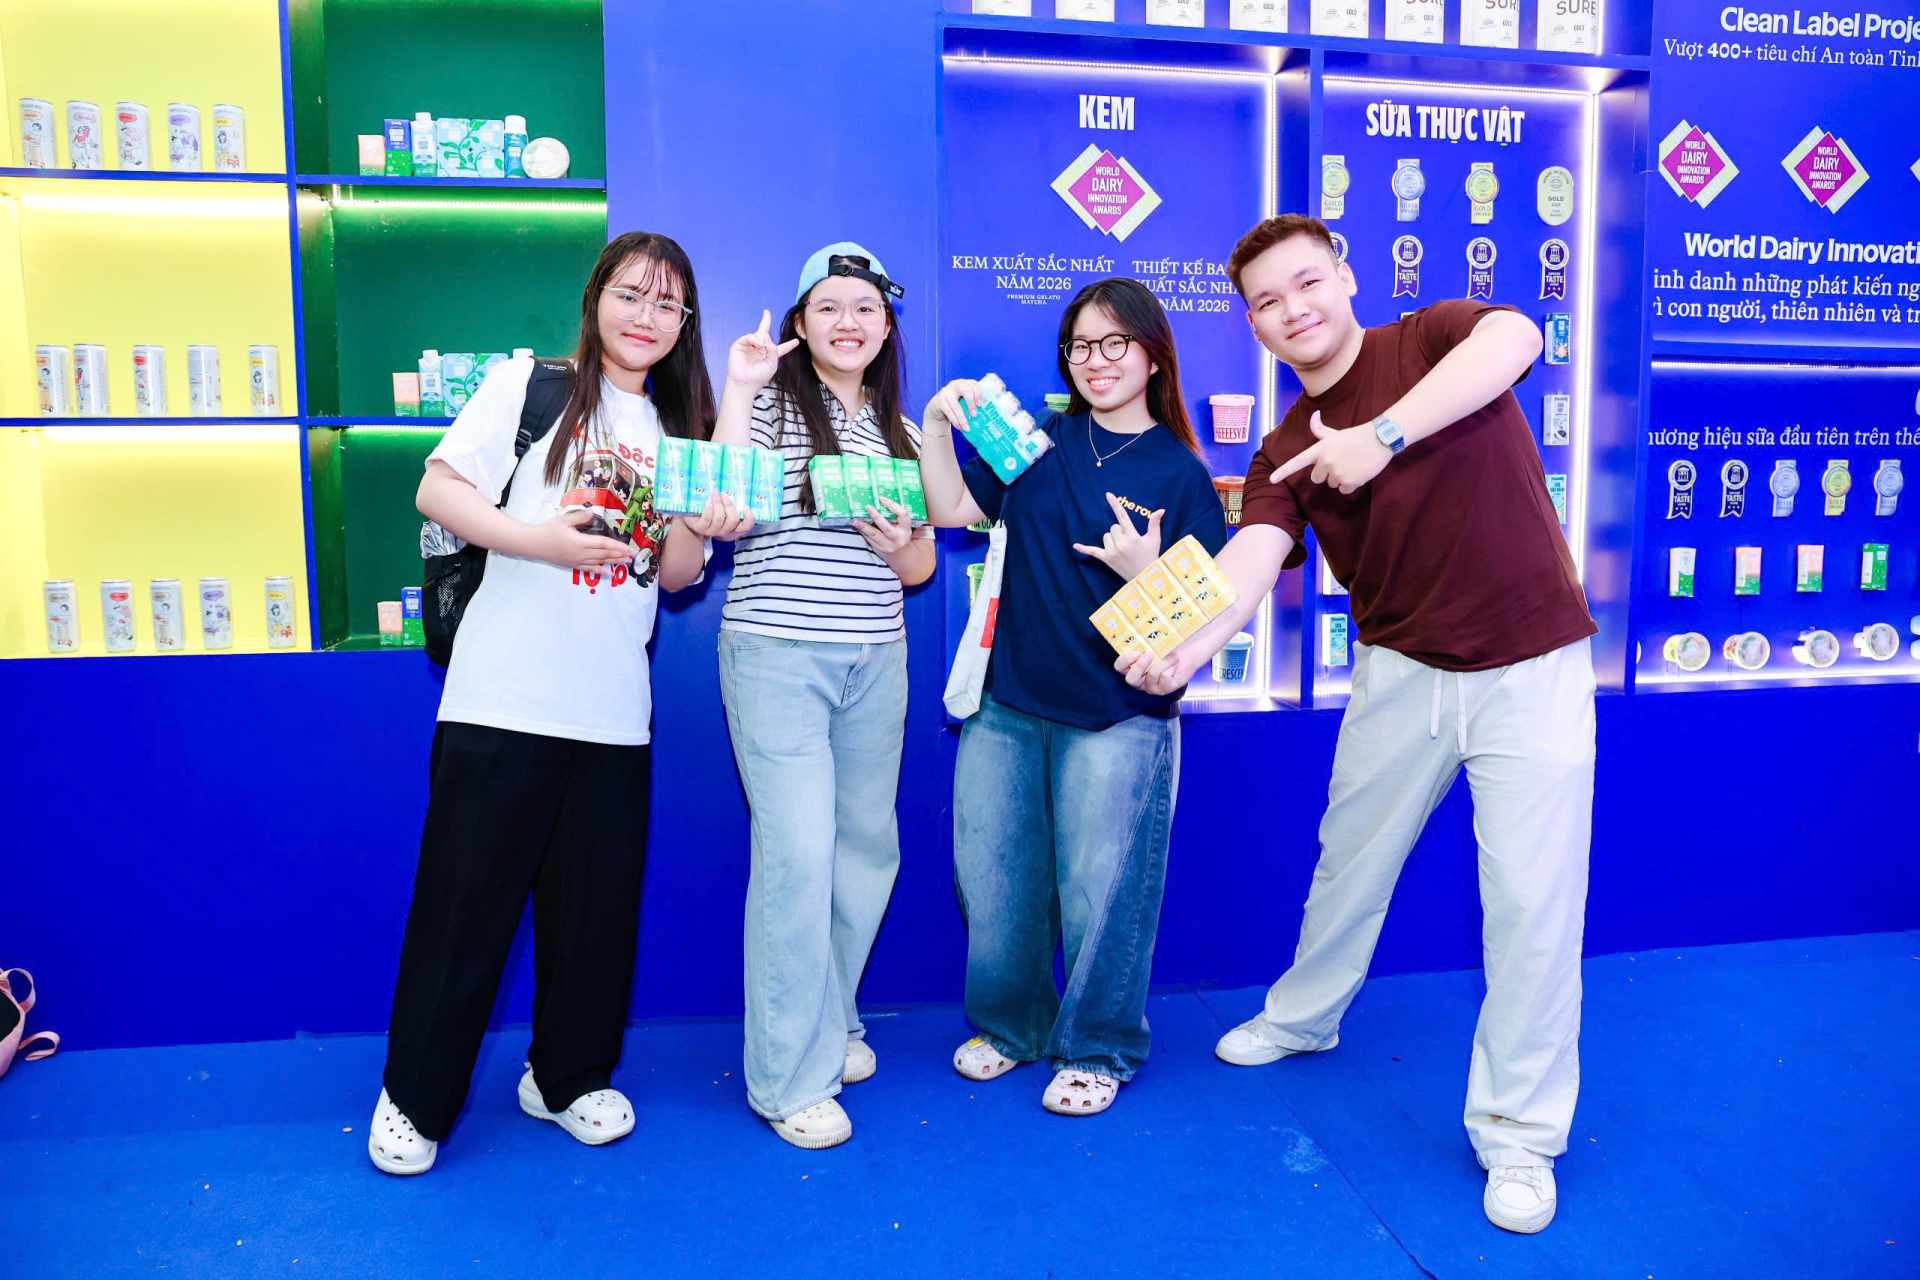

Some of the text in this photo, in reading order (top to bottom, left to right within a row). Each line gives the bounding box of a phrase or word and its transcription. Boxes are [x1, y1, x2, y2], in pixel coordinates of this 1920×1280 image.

[1720, 6, 1789, 34] Clean
[1793, 10, 1861, 38] Label
[1663, 38, 1704, 61] Vượt
[1707, 42, 1753, 59] 400+
[1756, 43, 1788, 61] tiêu
[1791, 45, 1817, 63] chí
[1820, 46, 1844, 64] An
[1849, 48, 1884, 65] toàn
[1079, 94, 1135, 131] KEM
[1366, 99, 1525, 146] SỮA THỰC VẬT
[1685, 140, 1706, 150] WORLD
[1817, 146, 1838, 156] WORLD
[1681, 150, 1708, 165] DAIRY
[1813, 157, 1840, 171] DAIRY
[1095, 166, 1120, 176] WORLD
[1677, 165, 1711, 175] INNOVATION
[1808, 171, 1842, 181] INNOVATION
[1091, 177, 1124, 193] DAIRY
[1680, 175, 1705, 184] AWARDS
[1811, 180, 1836, 190] AWARDS
[1087, 193, 1128, 204] INNOVATION
[1093, 205, 1122, 215] AWARDS
[1683, 232, 1756, 259] World
[1760, 235, 1824, 264] Dairy
[951, 252, 1115, 273] KEM XUẤT SẮC NHẤT
[1132, 257, 1227, 276] THIẾT KẾ BA
[996, 273, 1072, 290] NĂM 2026
[1178, 275, 1207, 293] SẮC
[1398, 273, 1417, 281] TASTE
[1472, 275, 1491, 283] TASTE
[1545, 275, 1564, 283] TASTE
[1689, 269, 1737, 291] danh
[1741, 271, 1802, 298] những
[1805, 274, 1848, 299] phát
[1852, 273, 1892, 296] kiến
[1158, 295, 1230, 313] NĂM 2026
[1667, 301, 1702, 317] con
[1706, 299, 1766, 323] người,
[1771, 300, 1819, 321] thiên
[1823, 301, 1876, 322] nhiên
[1881, 303, 1901, 323] và
[984, 401, 1019, 444] Vinamilk
[1704, 426, 1742, 450] hiệu
[1746, 427, 1775, 446] sữa
[1779, 424, 1811, 446] đầu
[1816, 426, 1849, 446] tiên
[1854, 427, 1890, 446] trên
[1116, 496, 1136, 510] the
[1674, 495, 1691, 503] TASTE
[1726, 494, 1743, 502] TASTE
